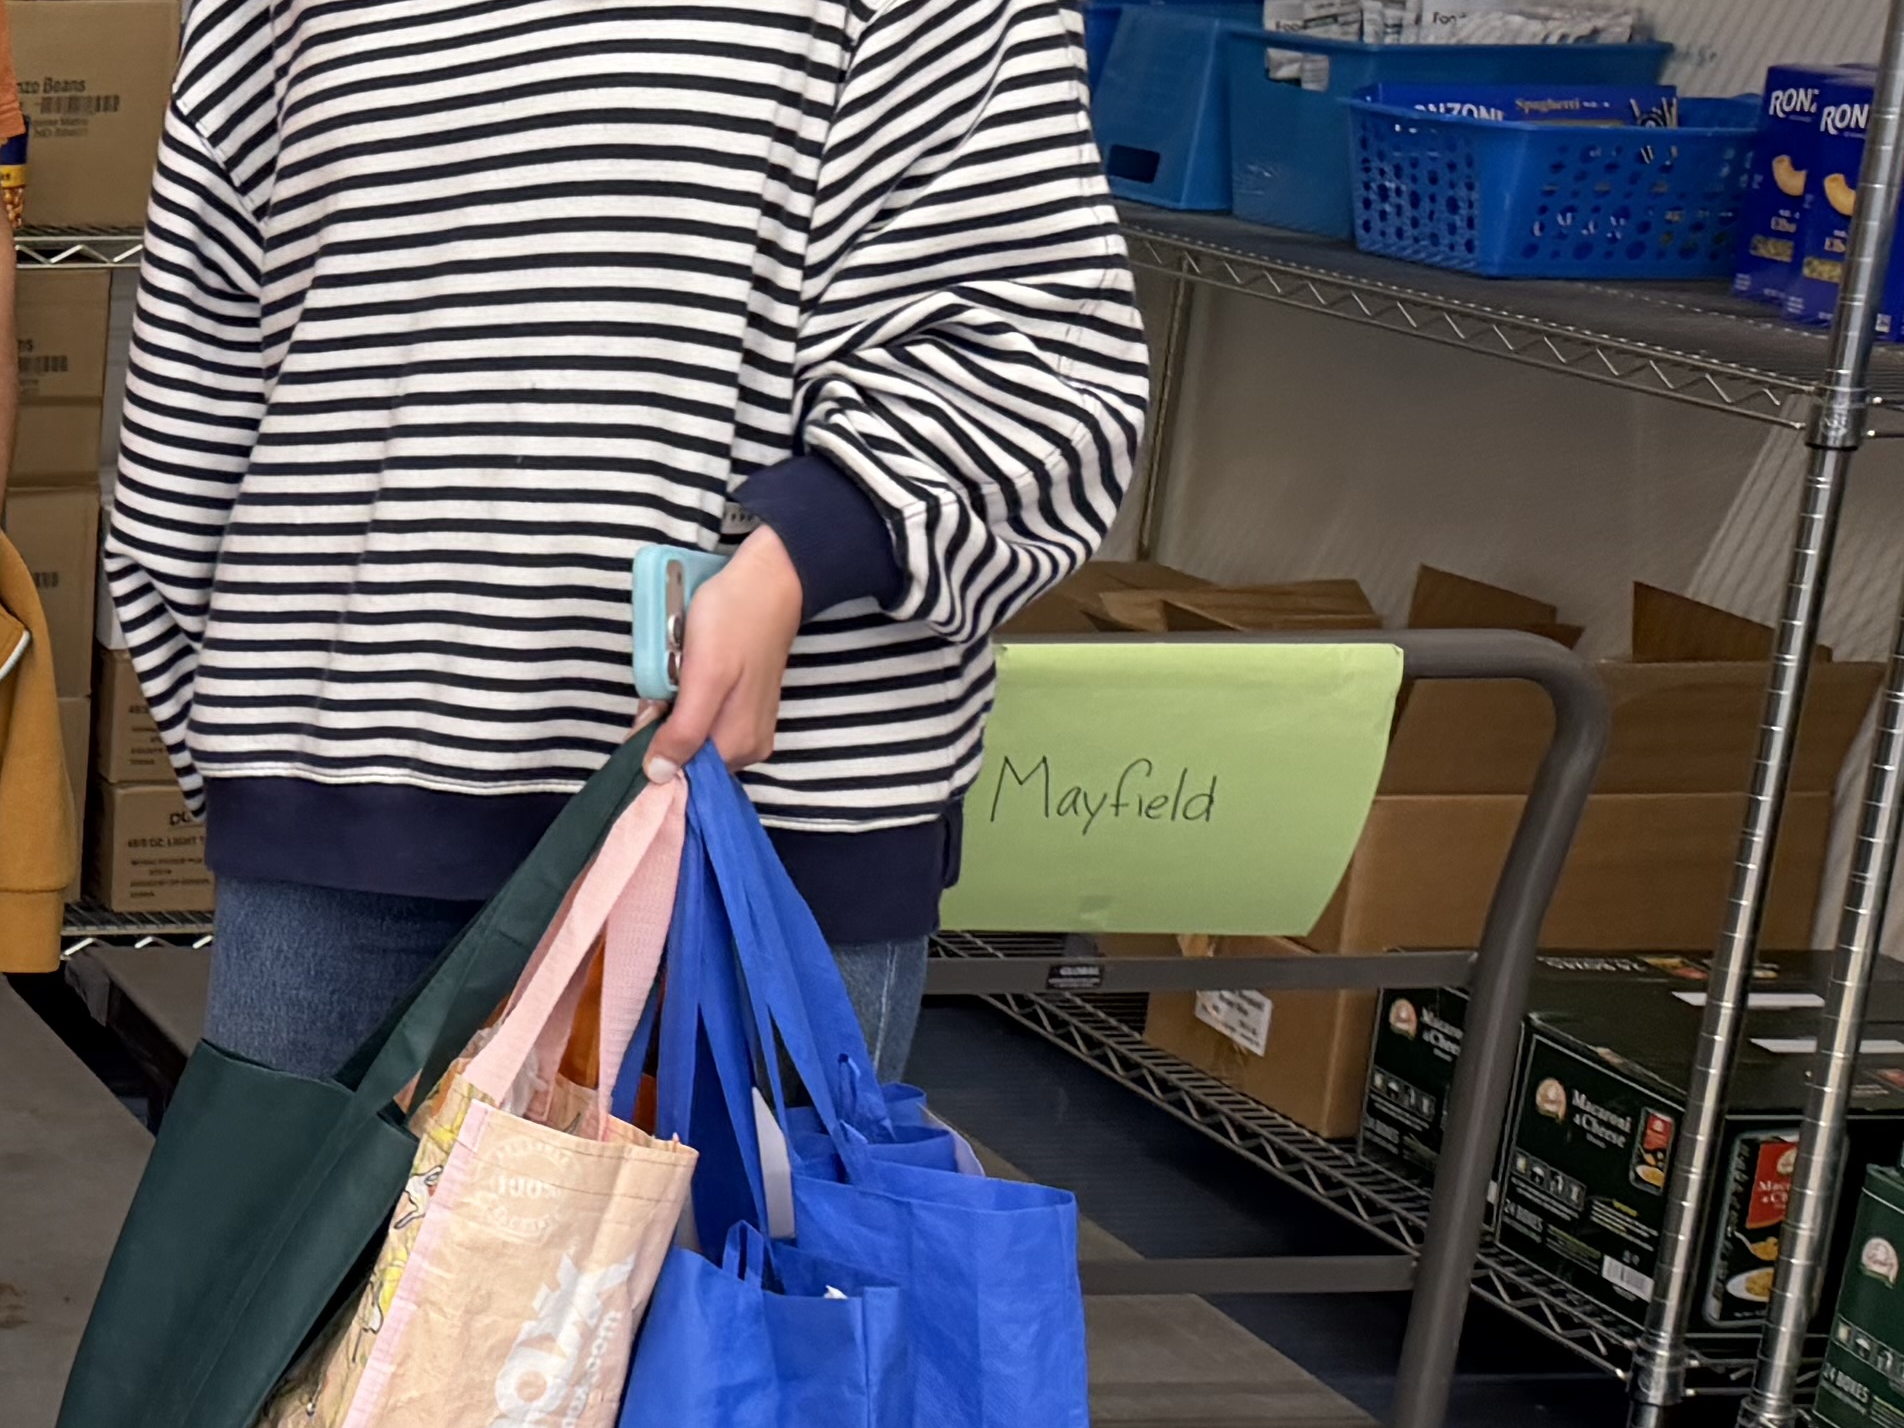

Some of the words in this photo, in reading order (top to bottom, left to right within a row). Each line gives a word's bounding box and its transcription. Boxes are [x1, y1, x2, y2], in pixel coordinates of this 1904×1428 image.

[43, 77, 87, 94] Beans
[990, 755, 1219, 836] Mayfield
[1570, 1088, 1633, 1134] Macaroni
